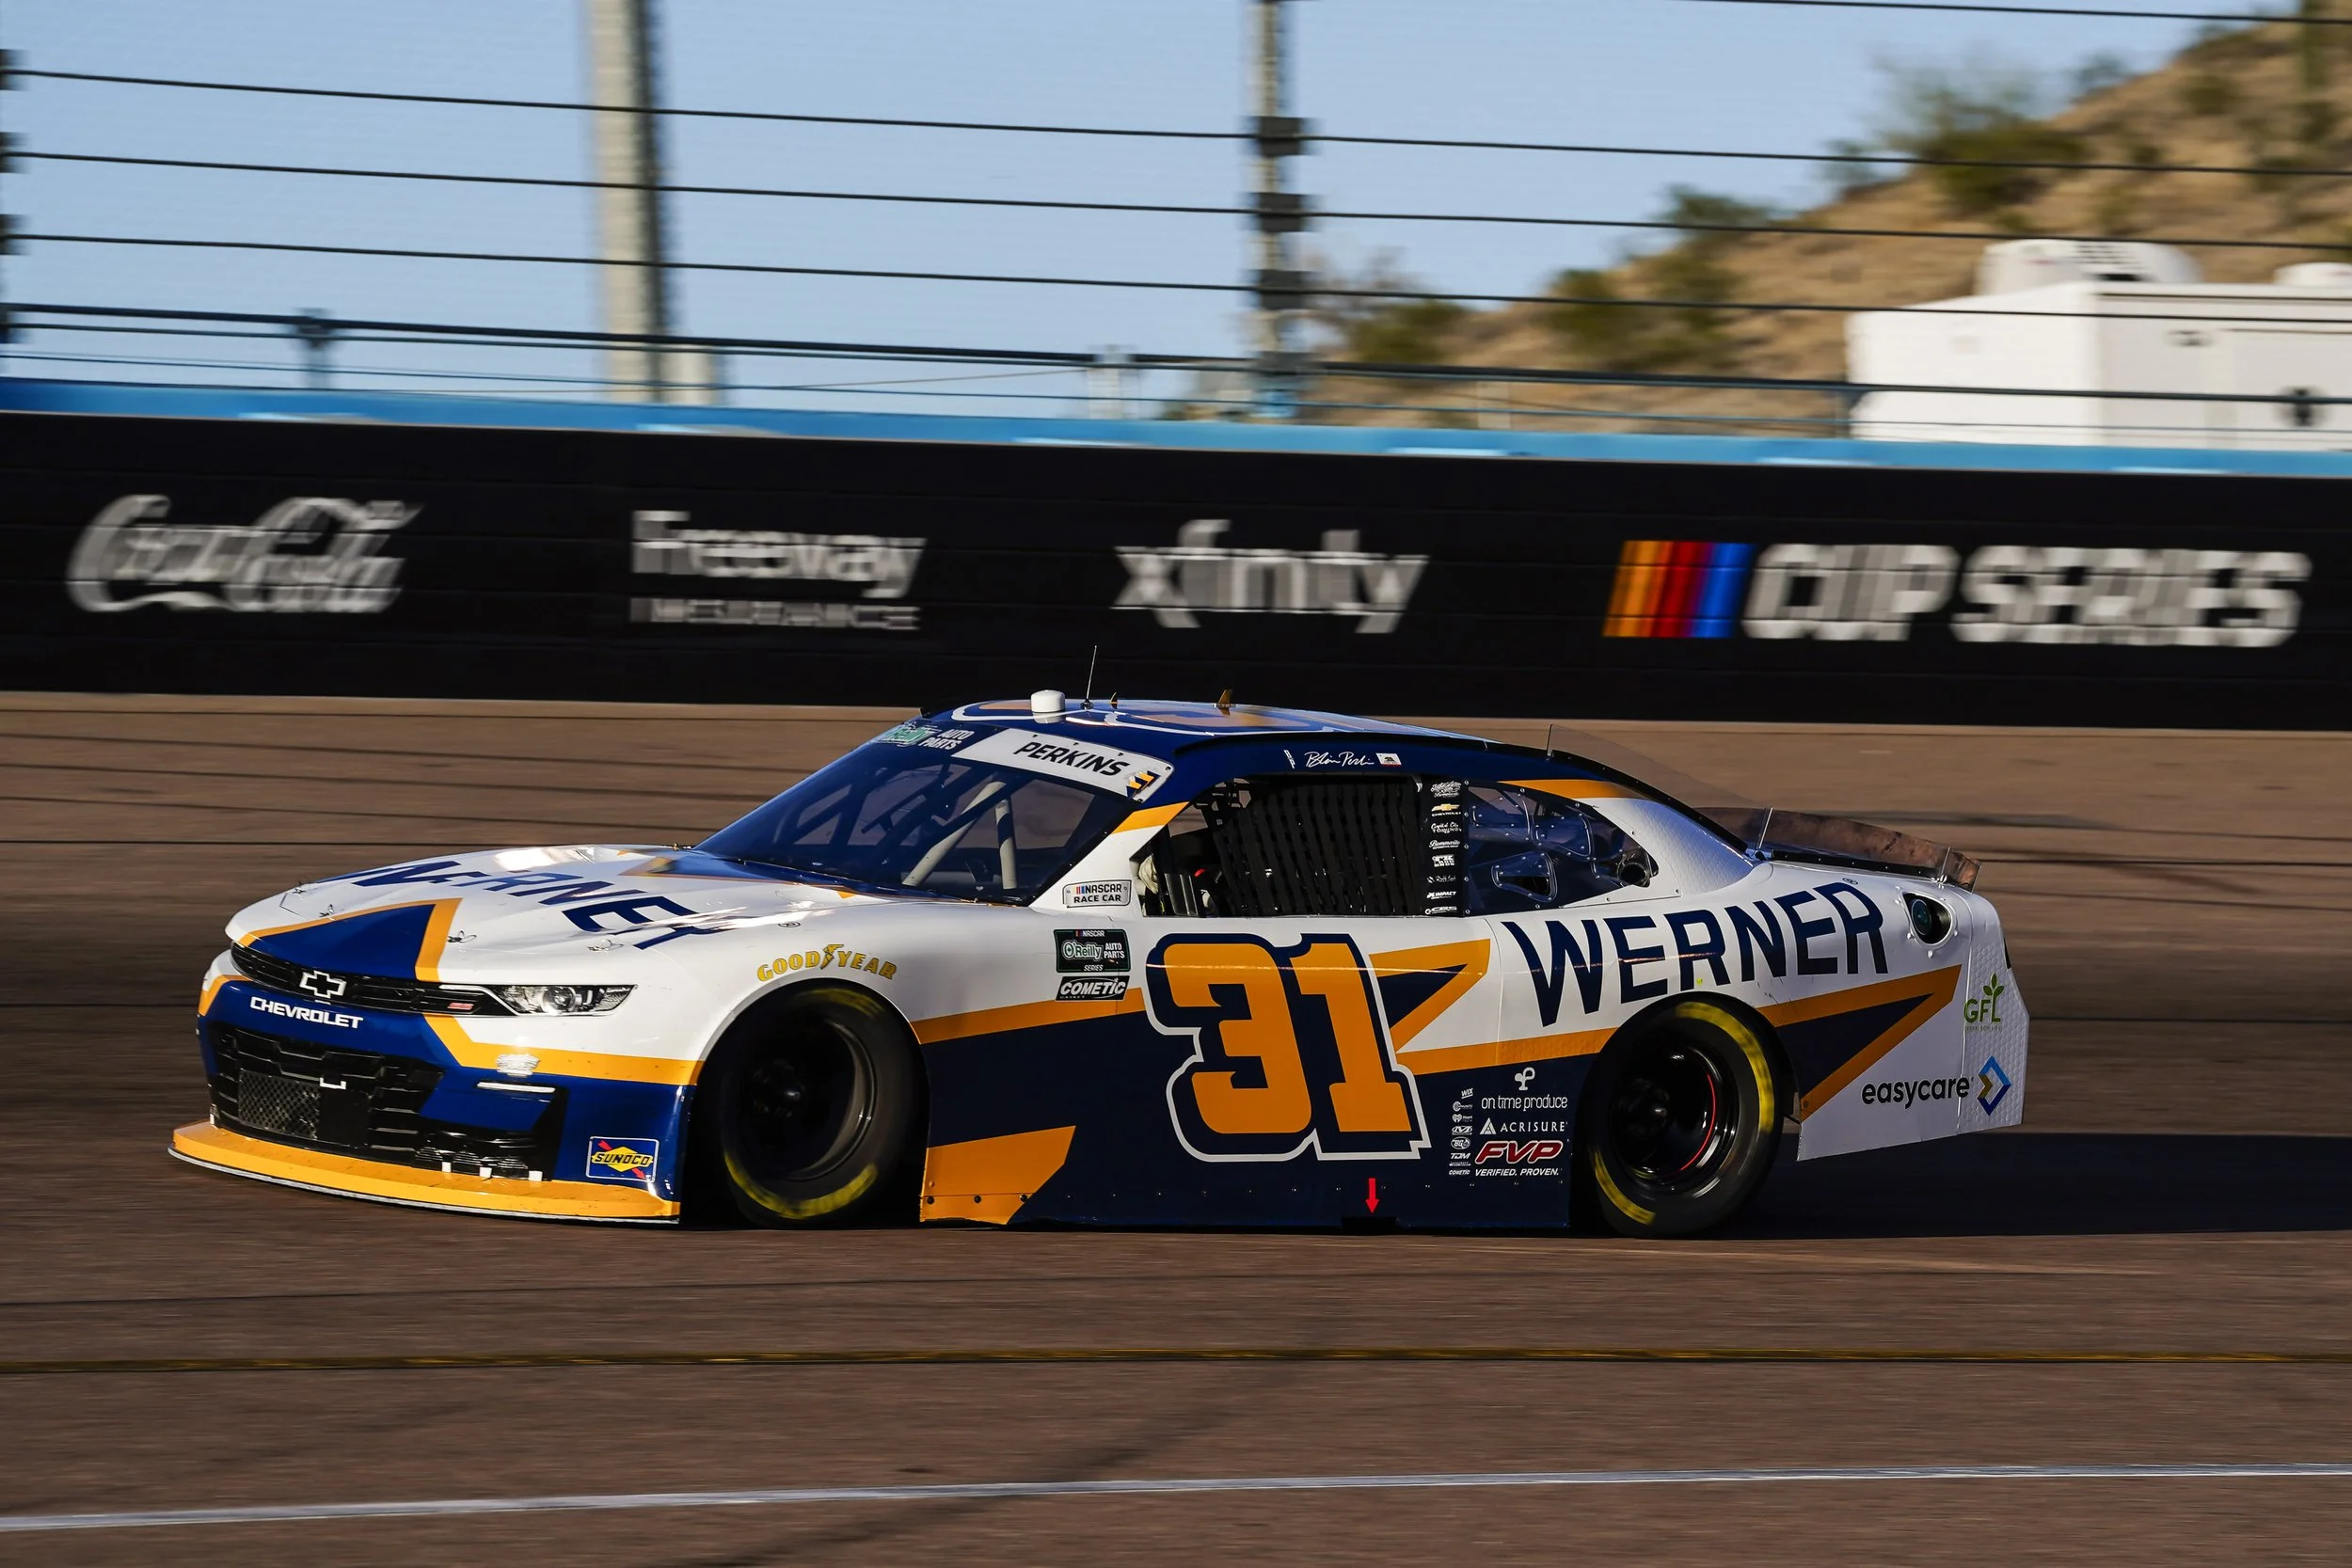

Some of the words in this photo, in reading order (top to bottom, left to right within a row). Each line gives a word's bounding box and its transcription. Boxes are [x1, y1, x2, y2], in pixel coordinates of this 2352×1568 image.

[631, 510, 927, 598] Freeway
[1110, 518, 1430, 634] xfinity
[1742, 543, 1961, 641] CUP
[1950, 545, 2312, 647] SERIES
[918, 736, 961, 751] PARTS
[937, 729, 975, 740] AUTO
[1013, 741, 1130, 776] PERKINS
[1073, 895, 1100, 904] RACE
[1102, 894, 1121, 902] CAR
[1085, 883, 1122, 895] NASCAR
[1061, 940, 1104, 962] O'Reilly
[1104, 942, 1122, 951] AUTO
[1104, 950, 1125, 959] PARTS
[1500, 881, 1889, 1027] WERNER
[1059, 978, 1126, 995] COMETIC
[1963, 972, 2005, 1023] GFL
[249, 996, 364, 1030] CHEVROLET
[1140, 932, 1432, 1162] 31
[1481, 1097, 1496, 1110] on
[1498, 1095, 1522, 1110] time
[1523, 1094, 1568, 1112] produce
[1861, 1076, 1970, 1110] easycare
[1500, 1121, 1565, 1132] ACRISURE
[594, 1152, 652, 1166] SUNOCO
[1474, 1140, 1564, 1164] FVP
[1474, 1168, 1518, 1177] VERIFIED.
[1519, 1168, 1560, 1177] PROVEN.
